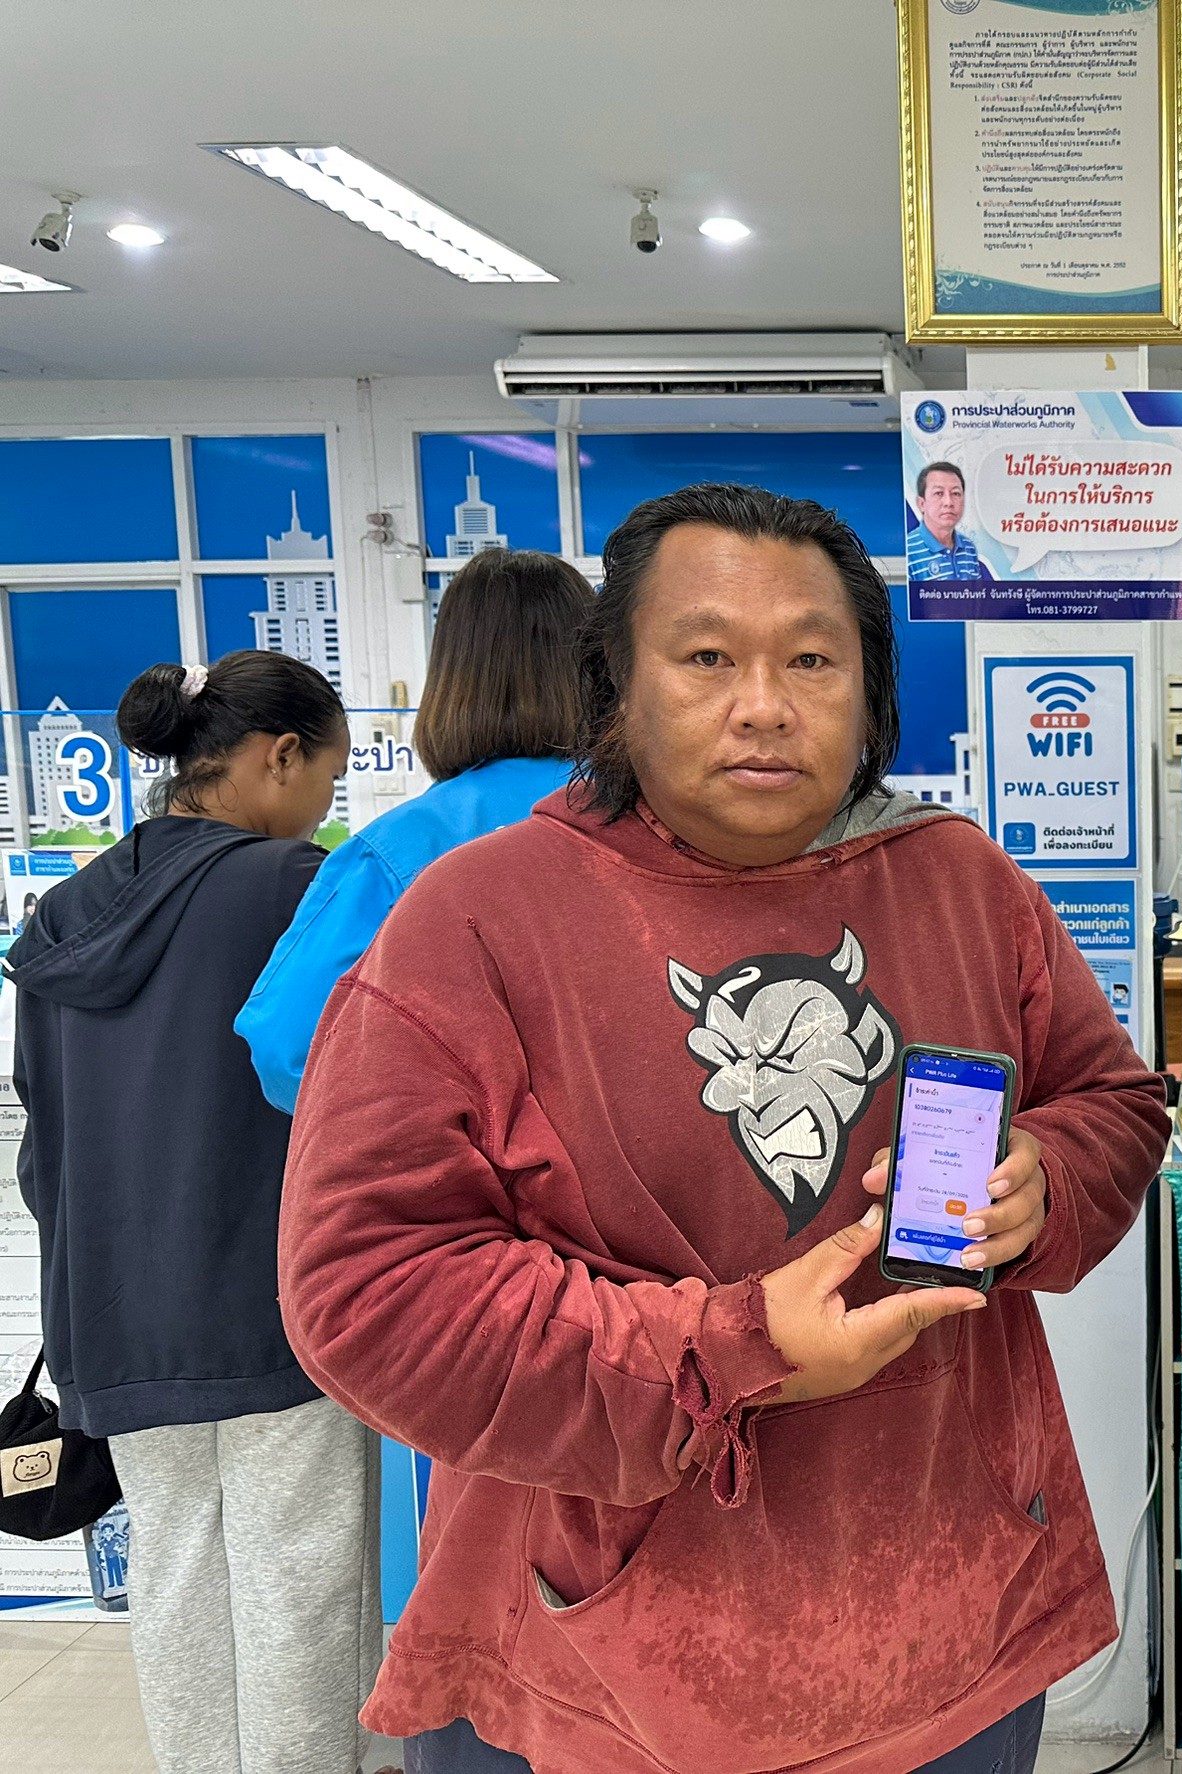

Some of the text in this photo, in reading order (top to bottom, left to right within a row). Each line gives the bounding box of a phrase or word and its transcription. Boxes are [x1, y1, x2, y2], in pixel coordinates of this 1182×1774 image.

[952, 403, 1075, 420] การประปาส่วนภูมิภาค
[952, 420, 1075, 430] Provincial Waterworks Authority
[1005, 454, 1172, 476] ไม่ได้รับความสะดวก
[1024, 483, 1153, 505] ในการให้บริการ
[1001, 512, 1178, 534] หรือต้องการเสนอแนะ
[919, 588, 941, 599] ติดต่อ
[1026, 603, 1098, 615] โทร.081-3799727
[1042, 716, 1078, 726] FREE
[1027, 732, 1093, 757] WIFI
[56, 731, 115, 821] 3
[1043, 823, 1115, 836] ติดต่อเจ้าหน้าที่
[1043, 838, 1113, 850] เพื่อลงทะเบียน
